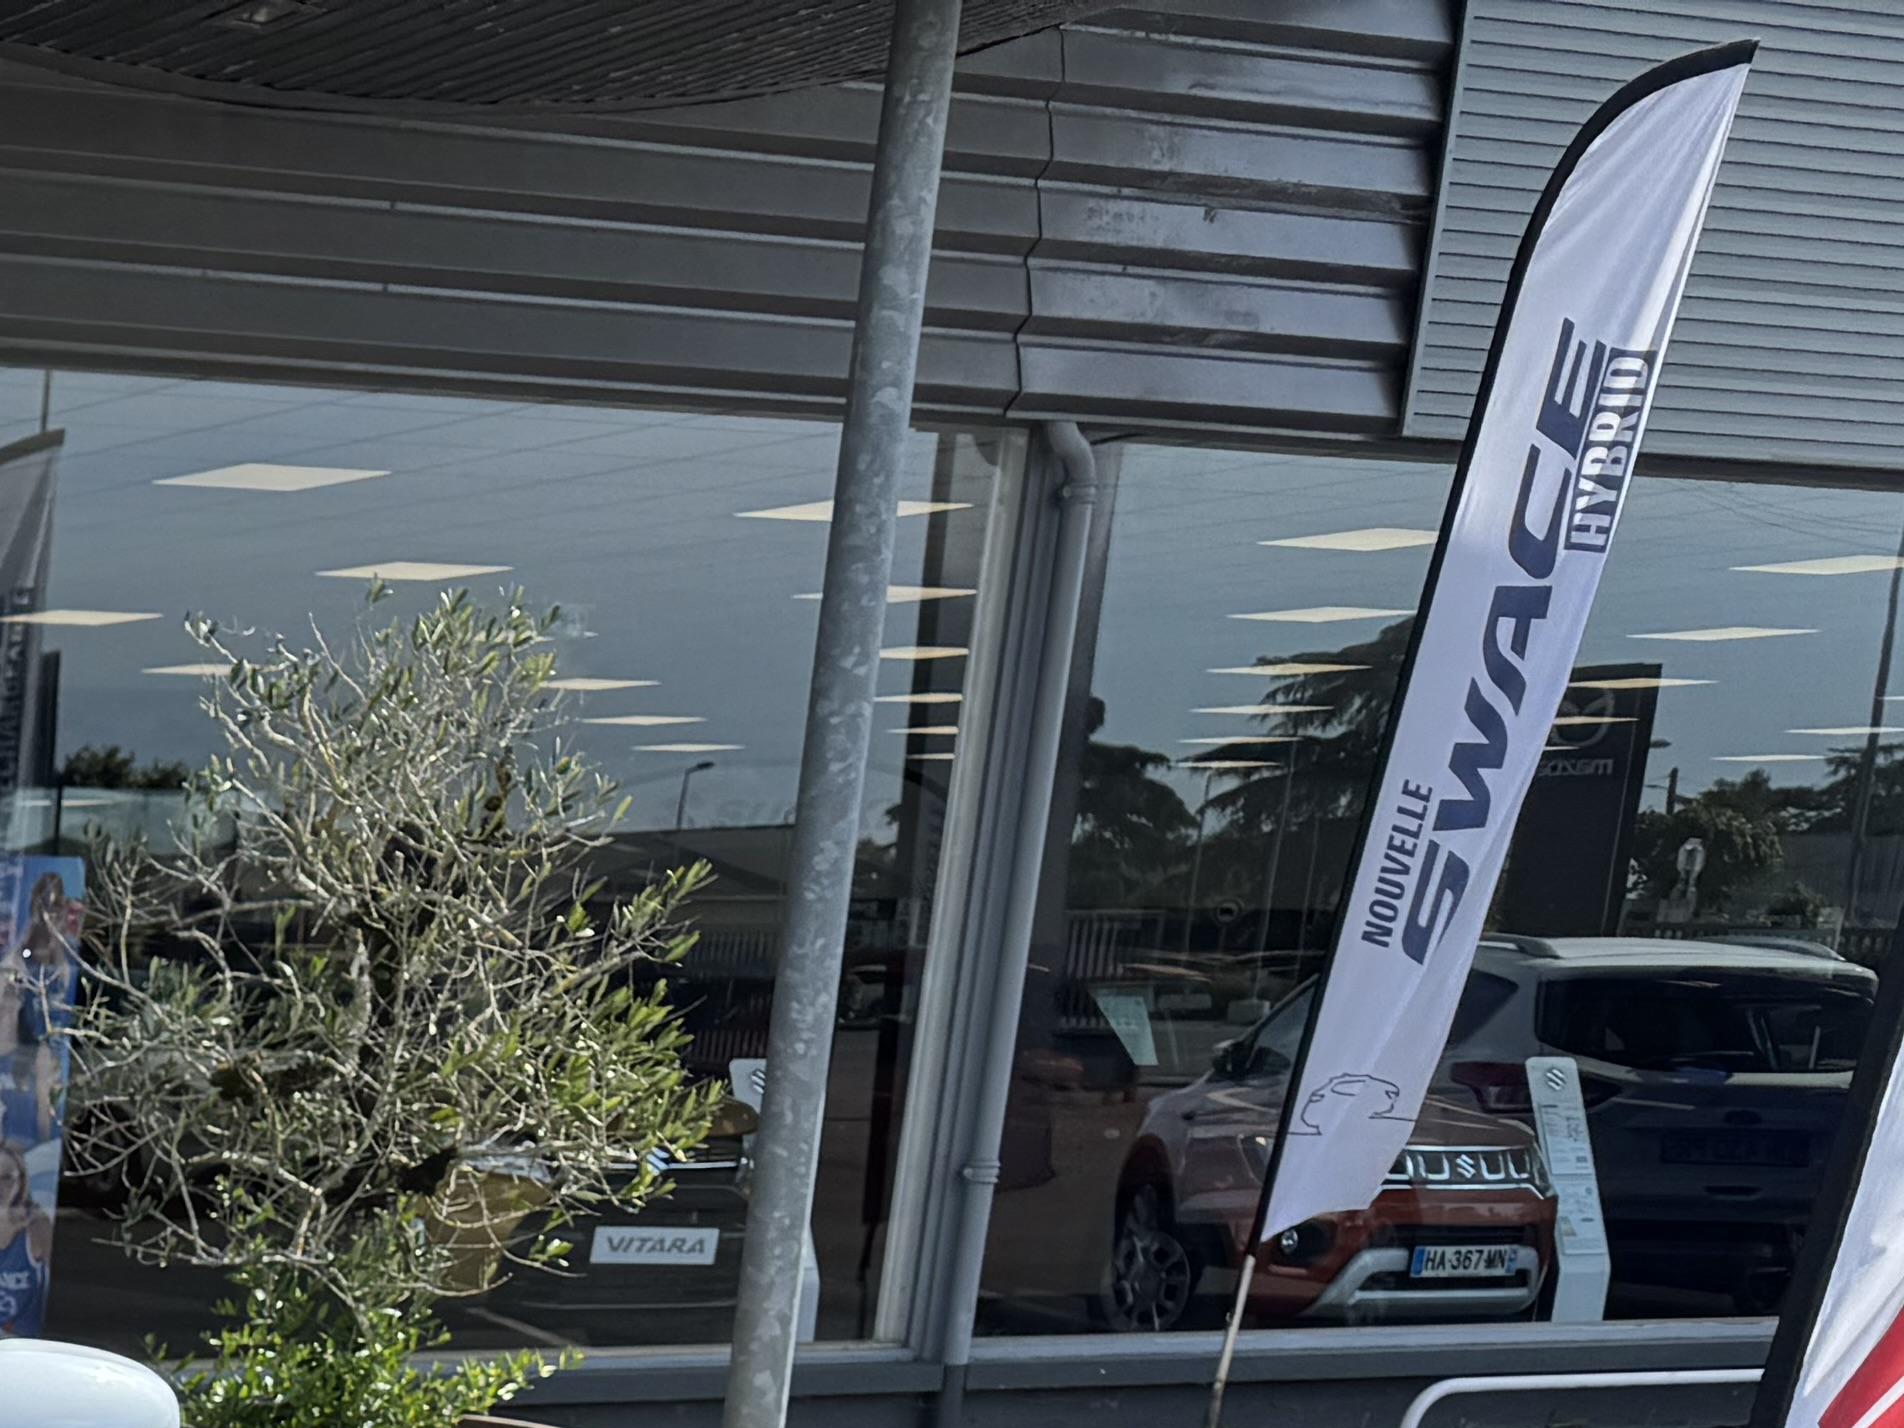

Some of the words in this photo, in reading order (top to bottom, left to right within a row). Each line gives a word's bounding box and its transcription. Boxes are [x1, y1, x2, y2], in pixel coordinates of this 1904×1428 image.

[1570, 355, 1649, 547] HYBRID
[1402, 317, 1607, 965] SWACE
[1361, 778, 1433, 948] NOUVELLE
[606, 1235, 705, 1255] VITARA
